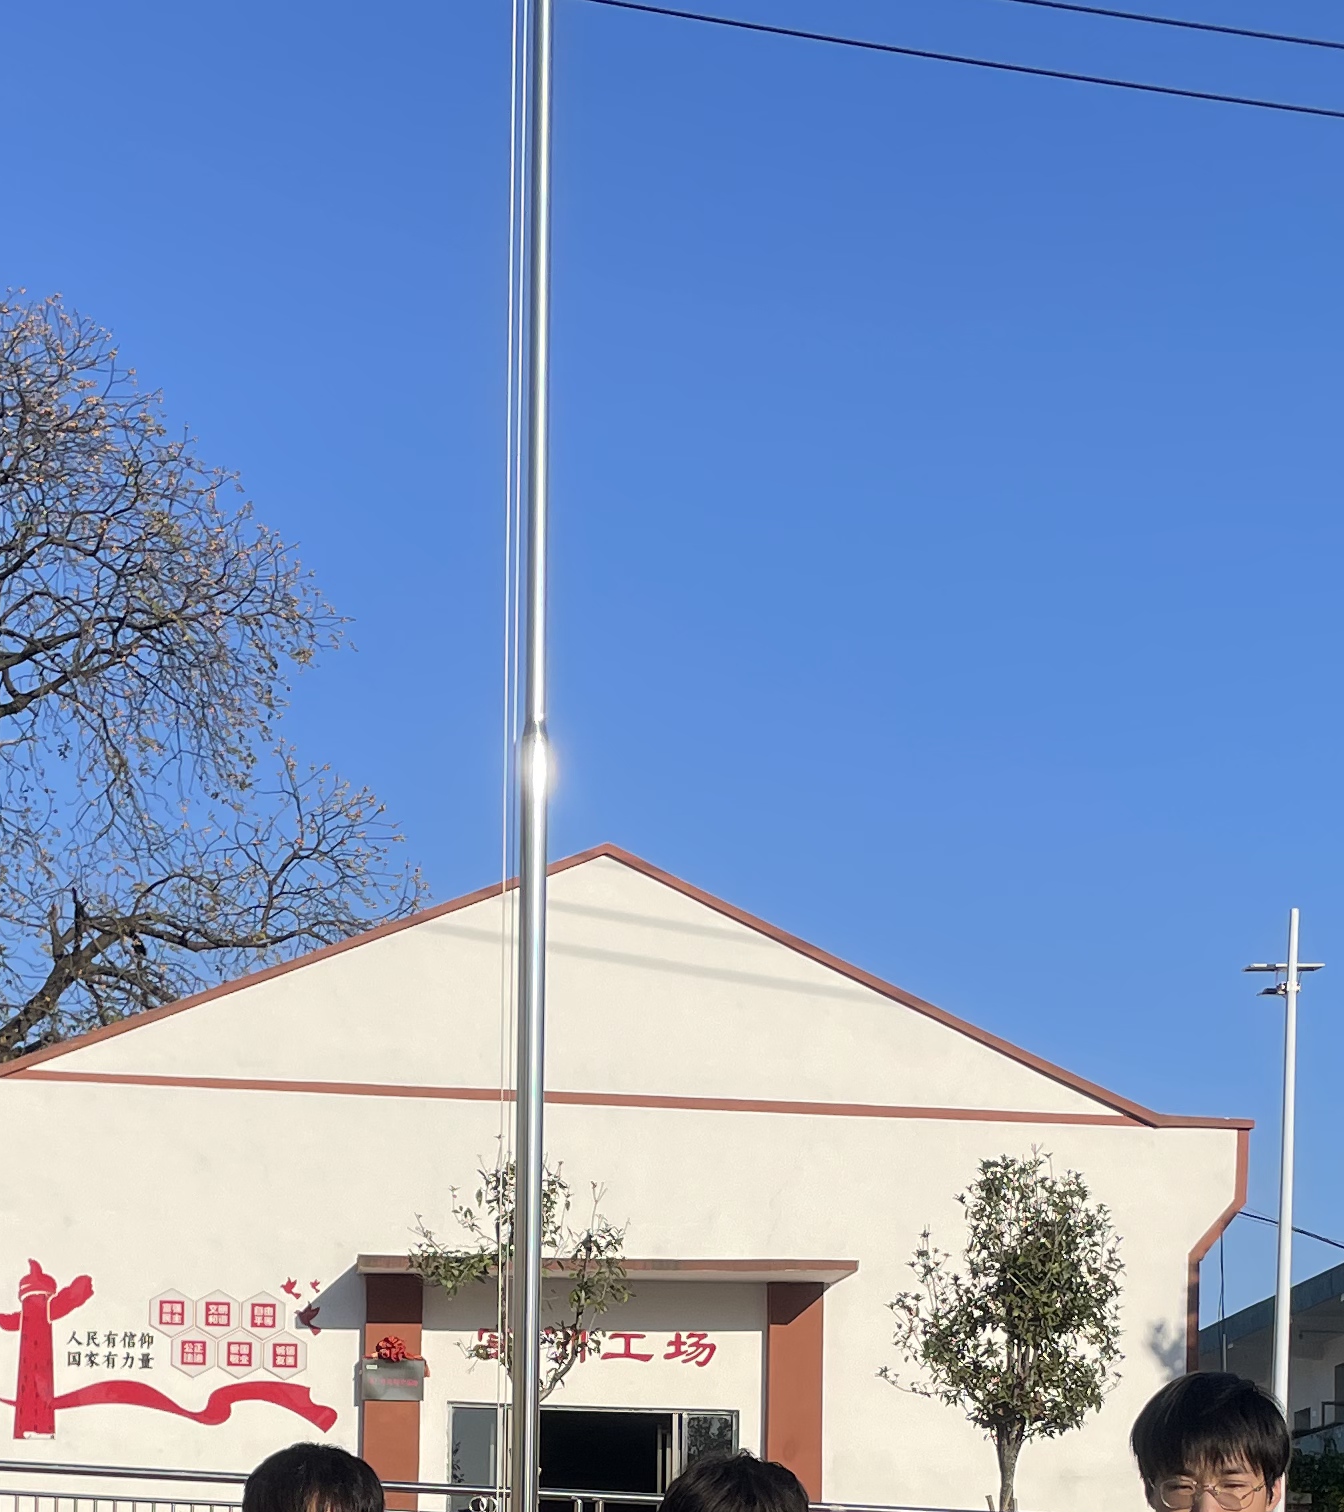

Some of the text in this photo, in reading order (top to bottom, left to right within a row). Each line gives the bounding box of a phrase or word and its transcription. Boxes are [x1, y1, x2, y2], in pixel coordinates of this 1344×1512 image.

[66, 1330, 155, 1349] 人民有信仰
[66, 1351, 155, 1370] 国家有力量
